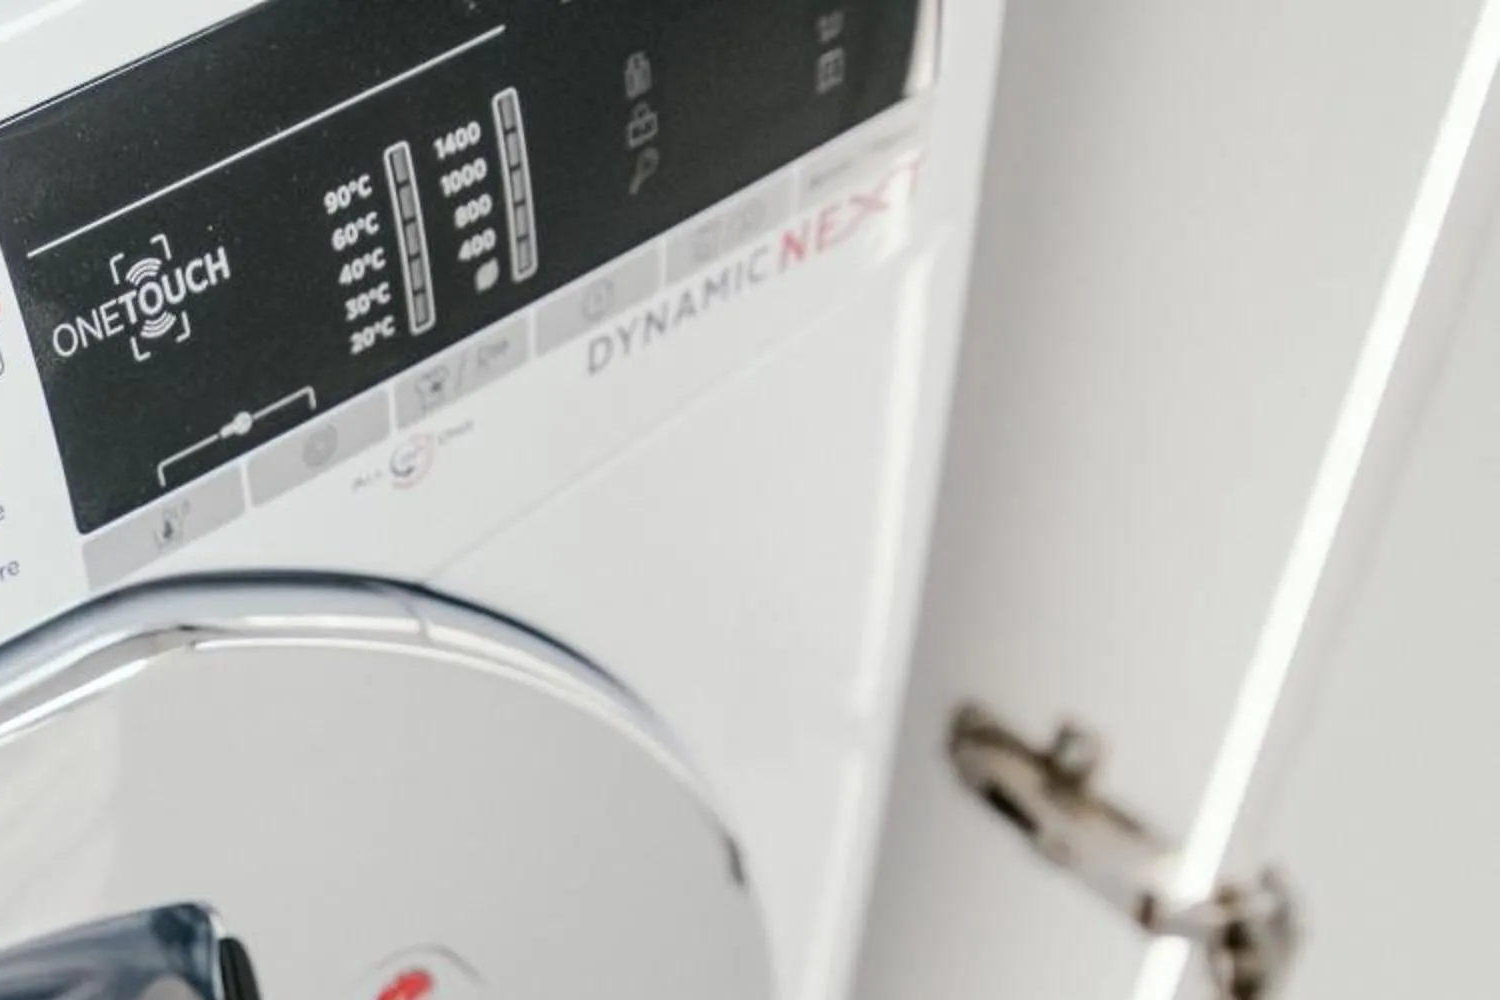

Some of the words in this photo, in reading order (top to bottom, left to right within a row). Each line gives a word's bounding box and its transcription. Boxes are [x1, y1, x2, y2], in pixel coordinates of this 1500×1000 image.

[434, 121, 481, 159] 1400
[324, 173, 373, 215] 90°C
[440, 157, 488, 197] 1000
[331, 211, 380, 251] 60°C
[454, 193, 493, 229] 800
[458, 228, 497, 261] 400
[338, 247, 387, 284] 40°C
[345, 281, 392, 321] 30°C
[350, 315, 396, 355] 20°C
